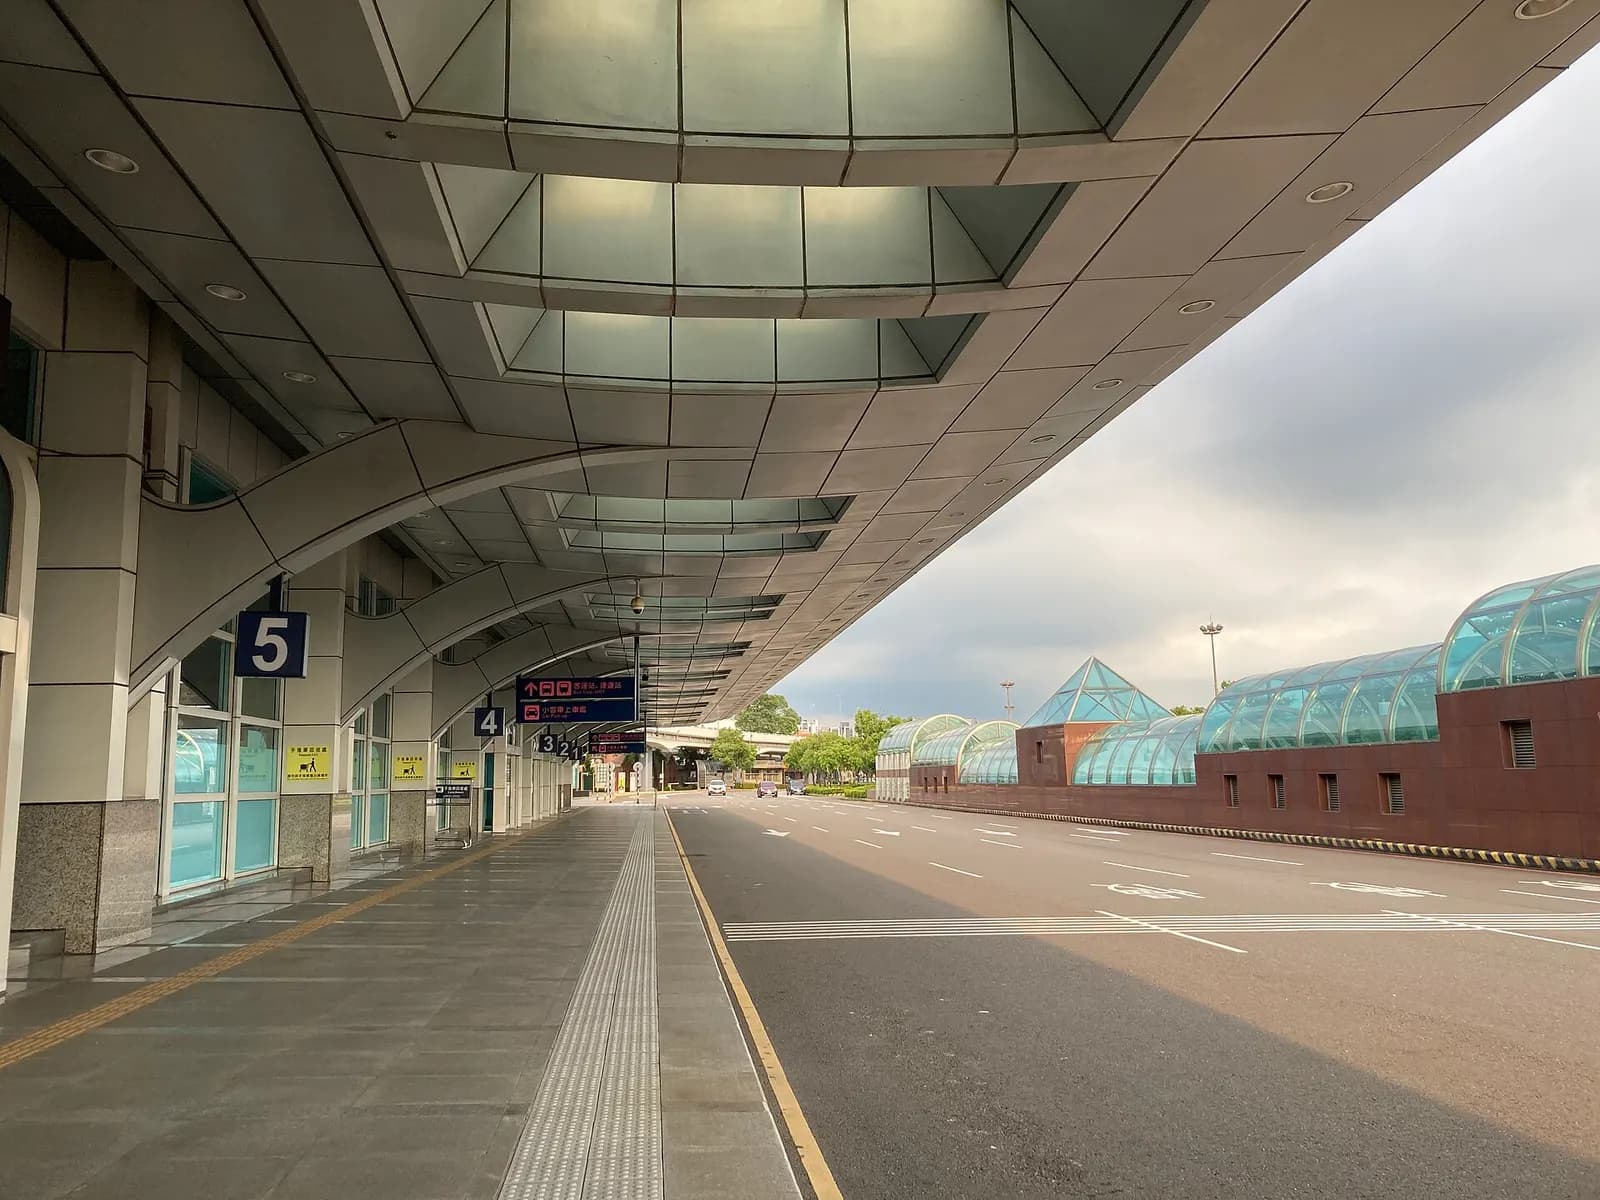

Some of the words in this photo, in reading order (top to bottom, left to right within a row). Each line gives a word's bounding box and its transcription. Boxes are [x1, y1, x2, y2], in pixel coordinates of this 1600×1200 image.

[252, 617, 288, 672] 5
[480, 710, 498, 734] 4
[543, 736, 554, 752] 3
[560, 743, 569, 756] 2
[572, 747, 579, 759] 1
